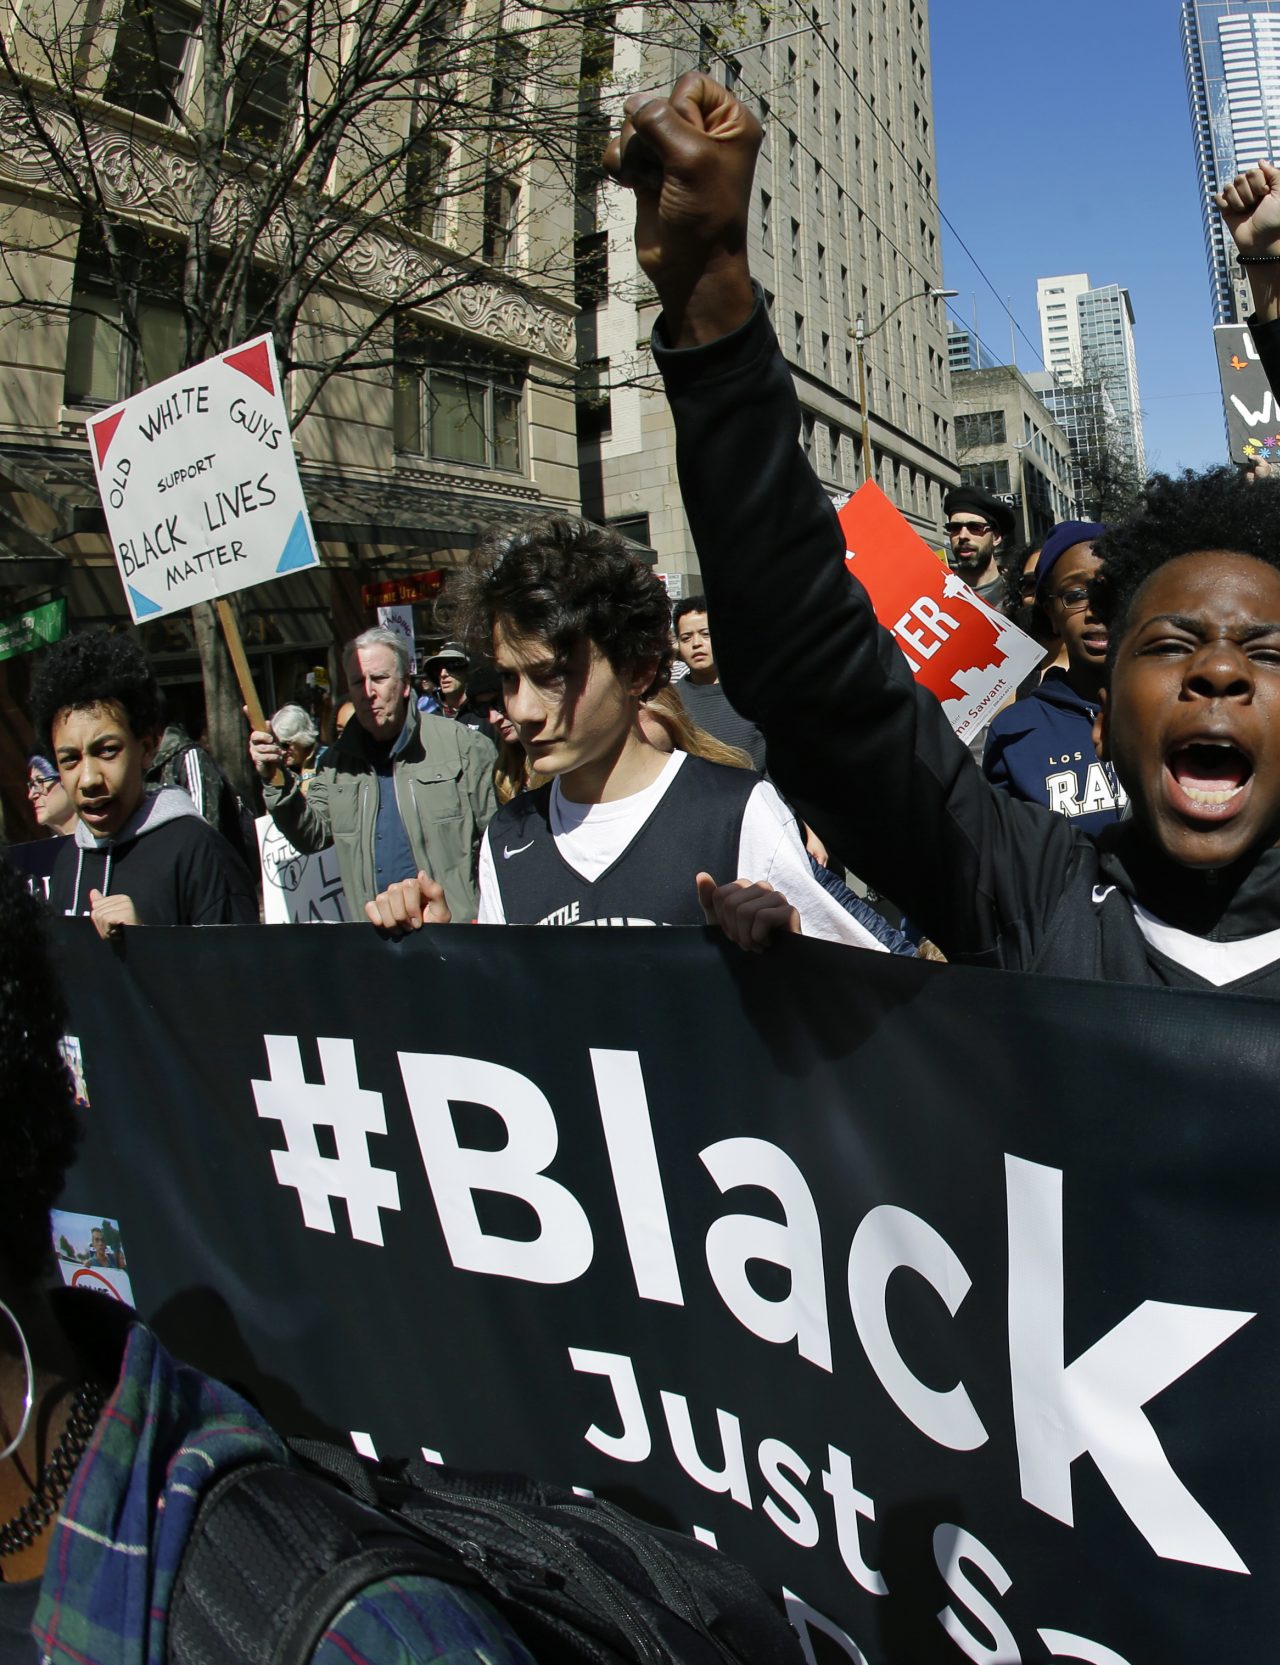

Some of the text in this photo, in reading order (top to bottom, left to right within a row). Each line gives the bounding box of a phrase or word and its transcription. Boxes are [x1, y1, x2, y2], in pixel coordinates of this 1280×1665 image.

[110, 386, 283, 509] OLD WHITE GUYS
[156, 453, 217, 494] SUPPORT
[118, 472, 277, 578] BLACK LIVES
[166, 540, 248, 591] MATTER
[968, 678, 1007, 719] Sawant
[1049, 751, 1083, 766] LOS
[1045, 762, 1129, 818] RA
[568, 1347, 890, 1596] Just
